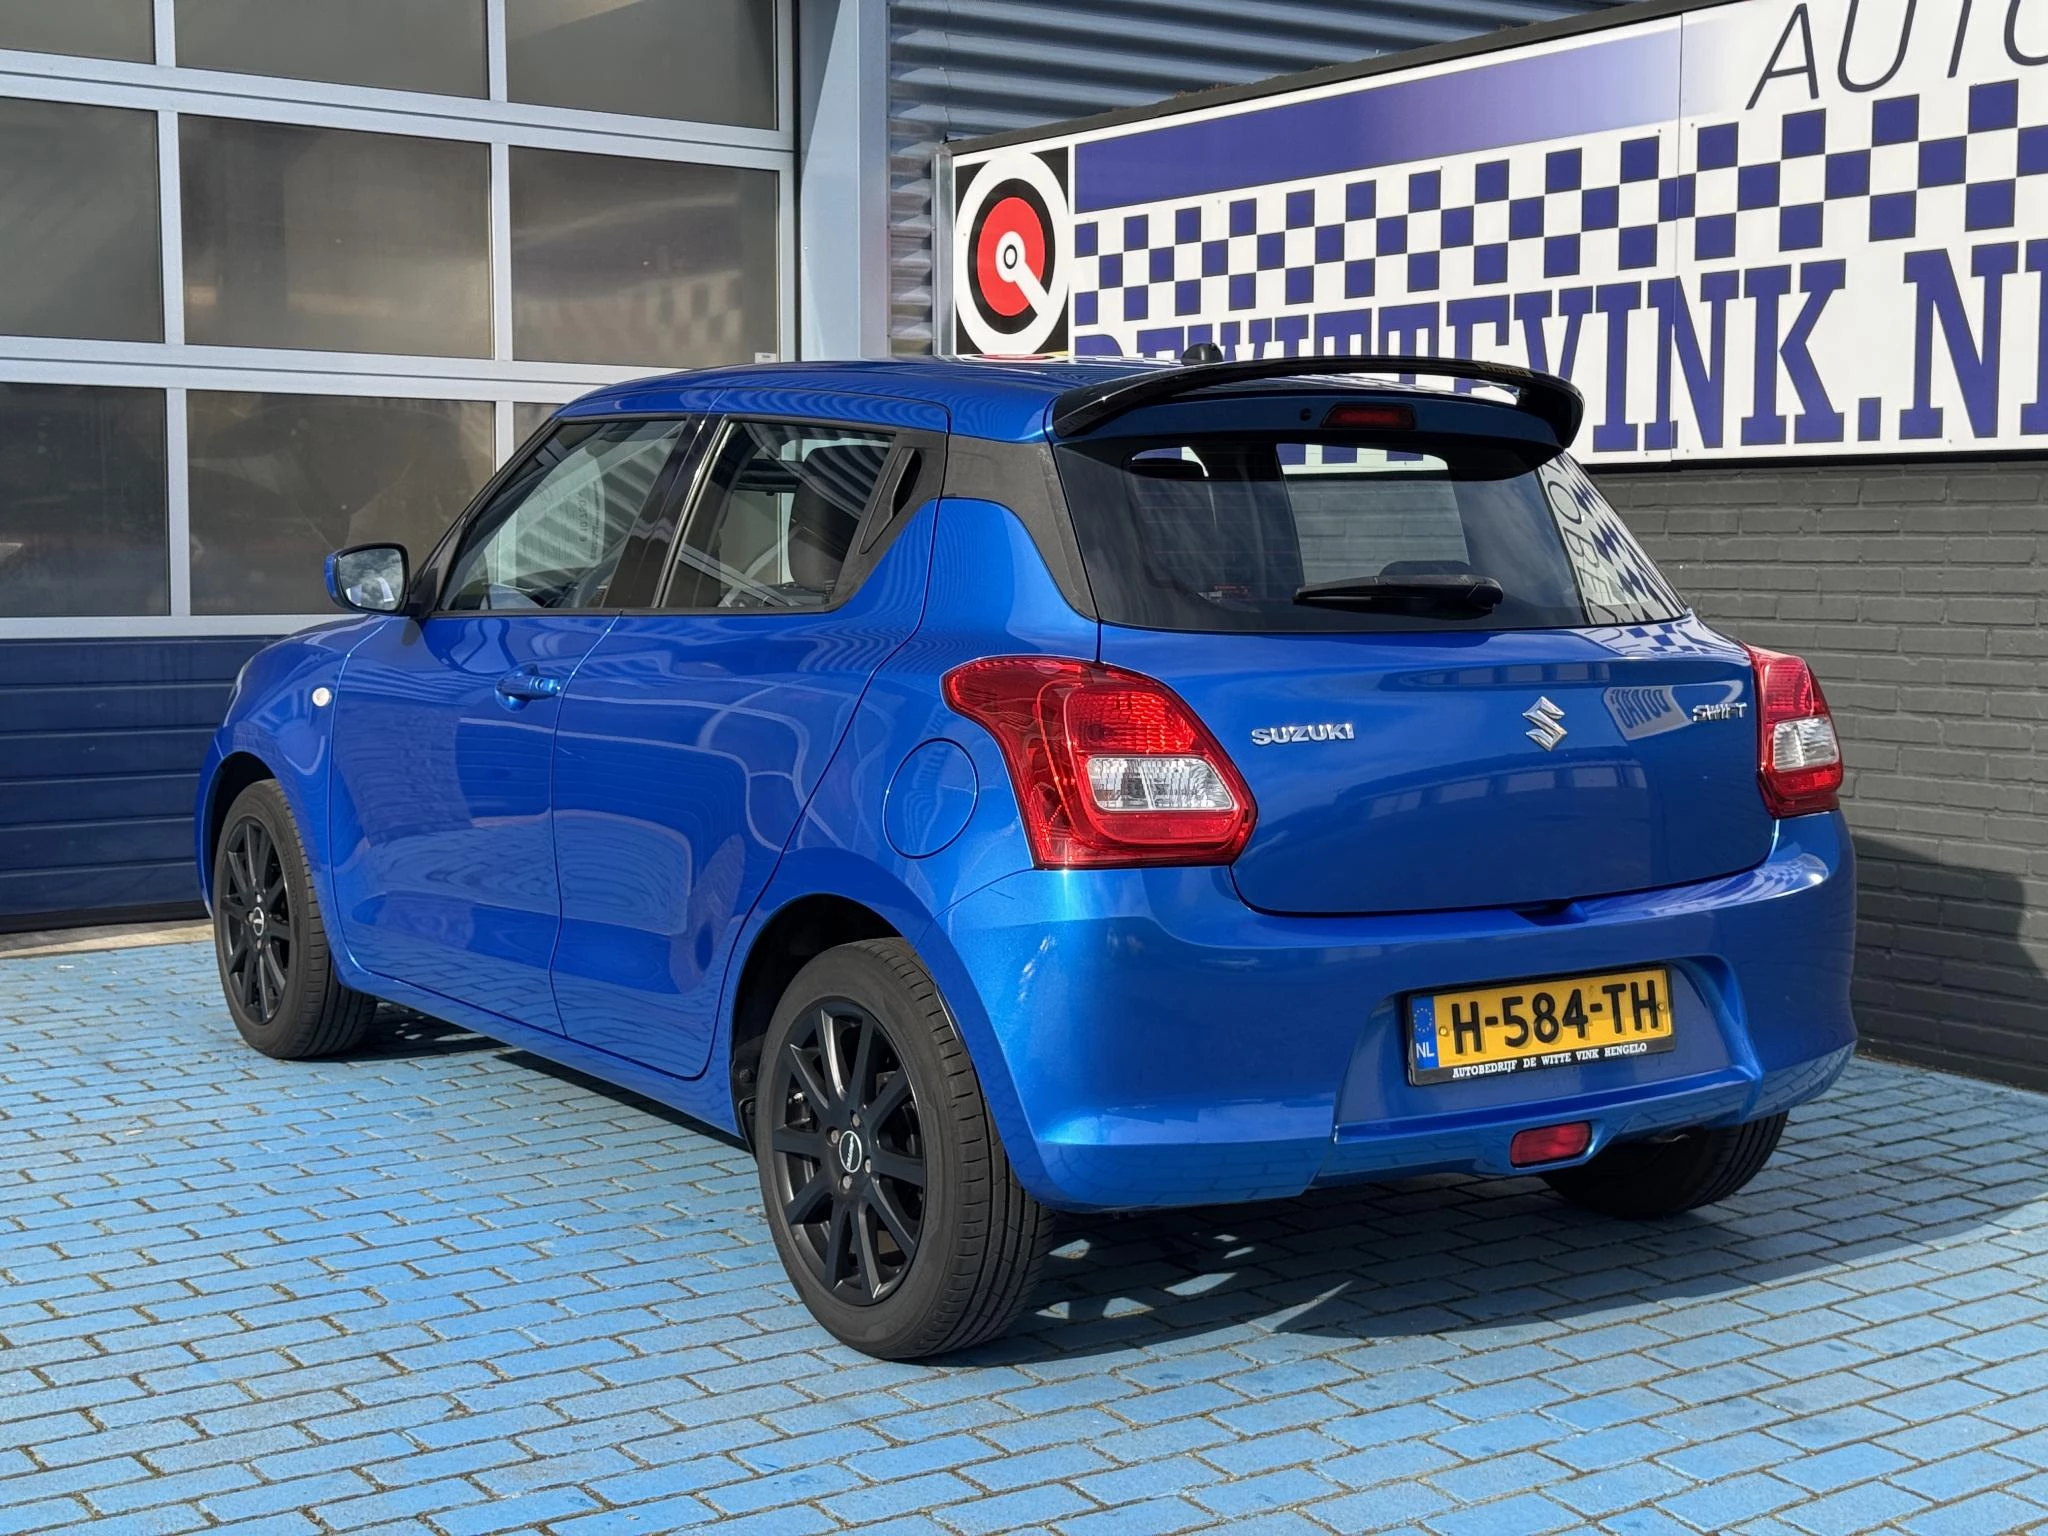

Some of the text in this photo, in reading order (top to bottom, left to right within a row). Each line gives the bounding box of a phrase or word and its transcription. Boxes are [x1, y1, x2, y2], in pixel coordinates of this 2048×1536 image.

[1074, 237, 2048, 452] TTEVINK.N
[1692, 702, 1748, 722] SWIFT
[1251, 723, 1355, 746] SUZUKI
[1451, 979, 1659, 1055] H-584-TH
[1416, 1042, 1435, 1058] NL
[1452, 1042, 1648, 1079] AUTOBEDRIJF DE WITTE VINK HENGELO
